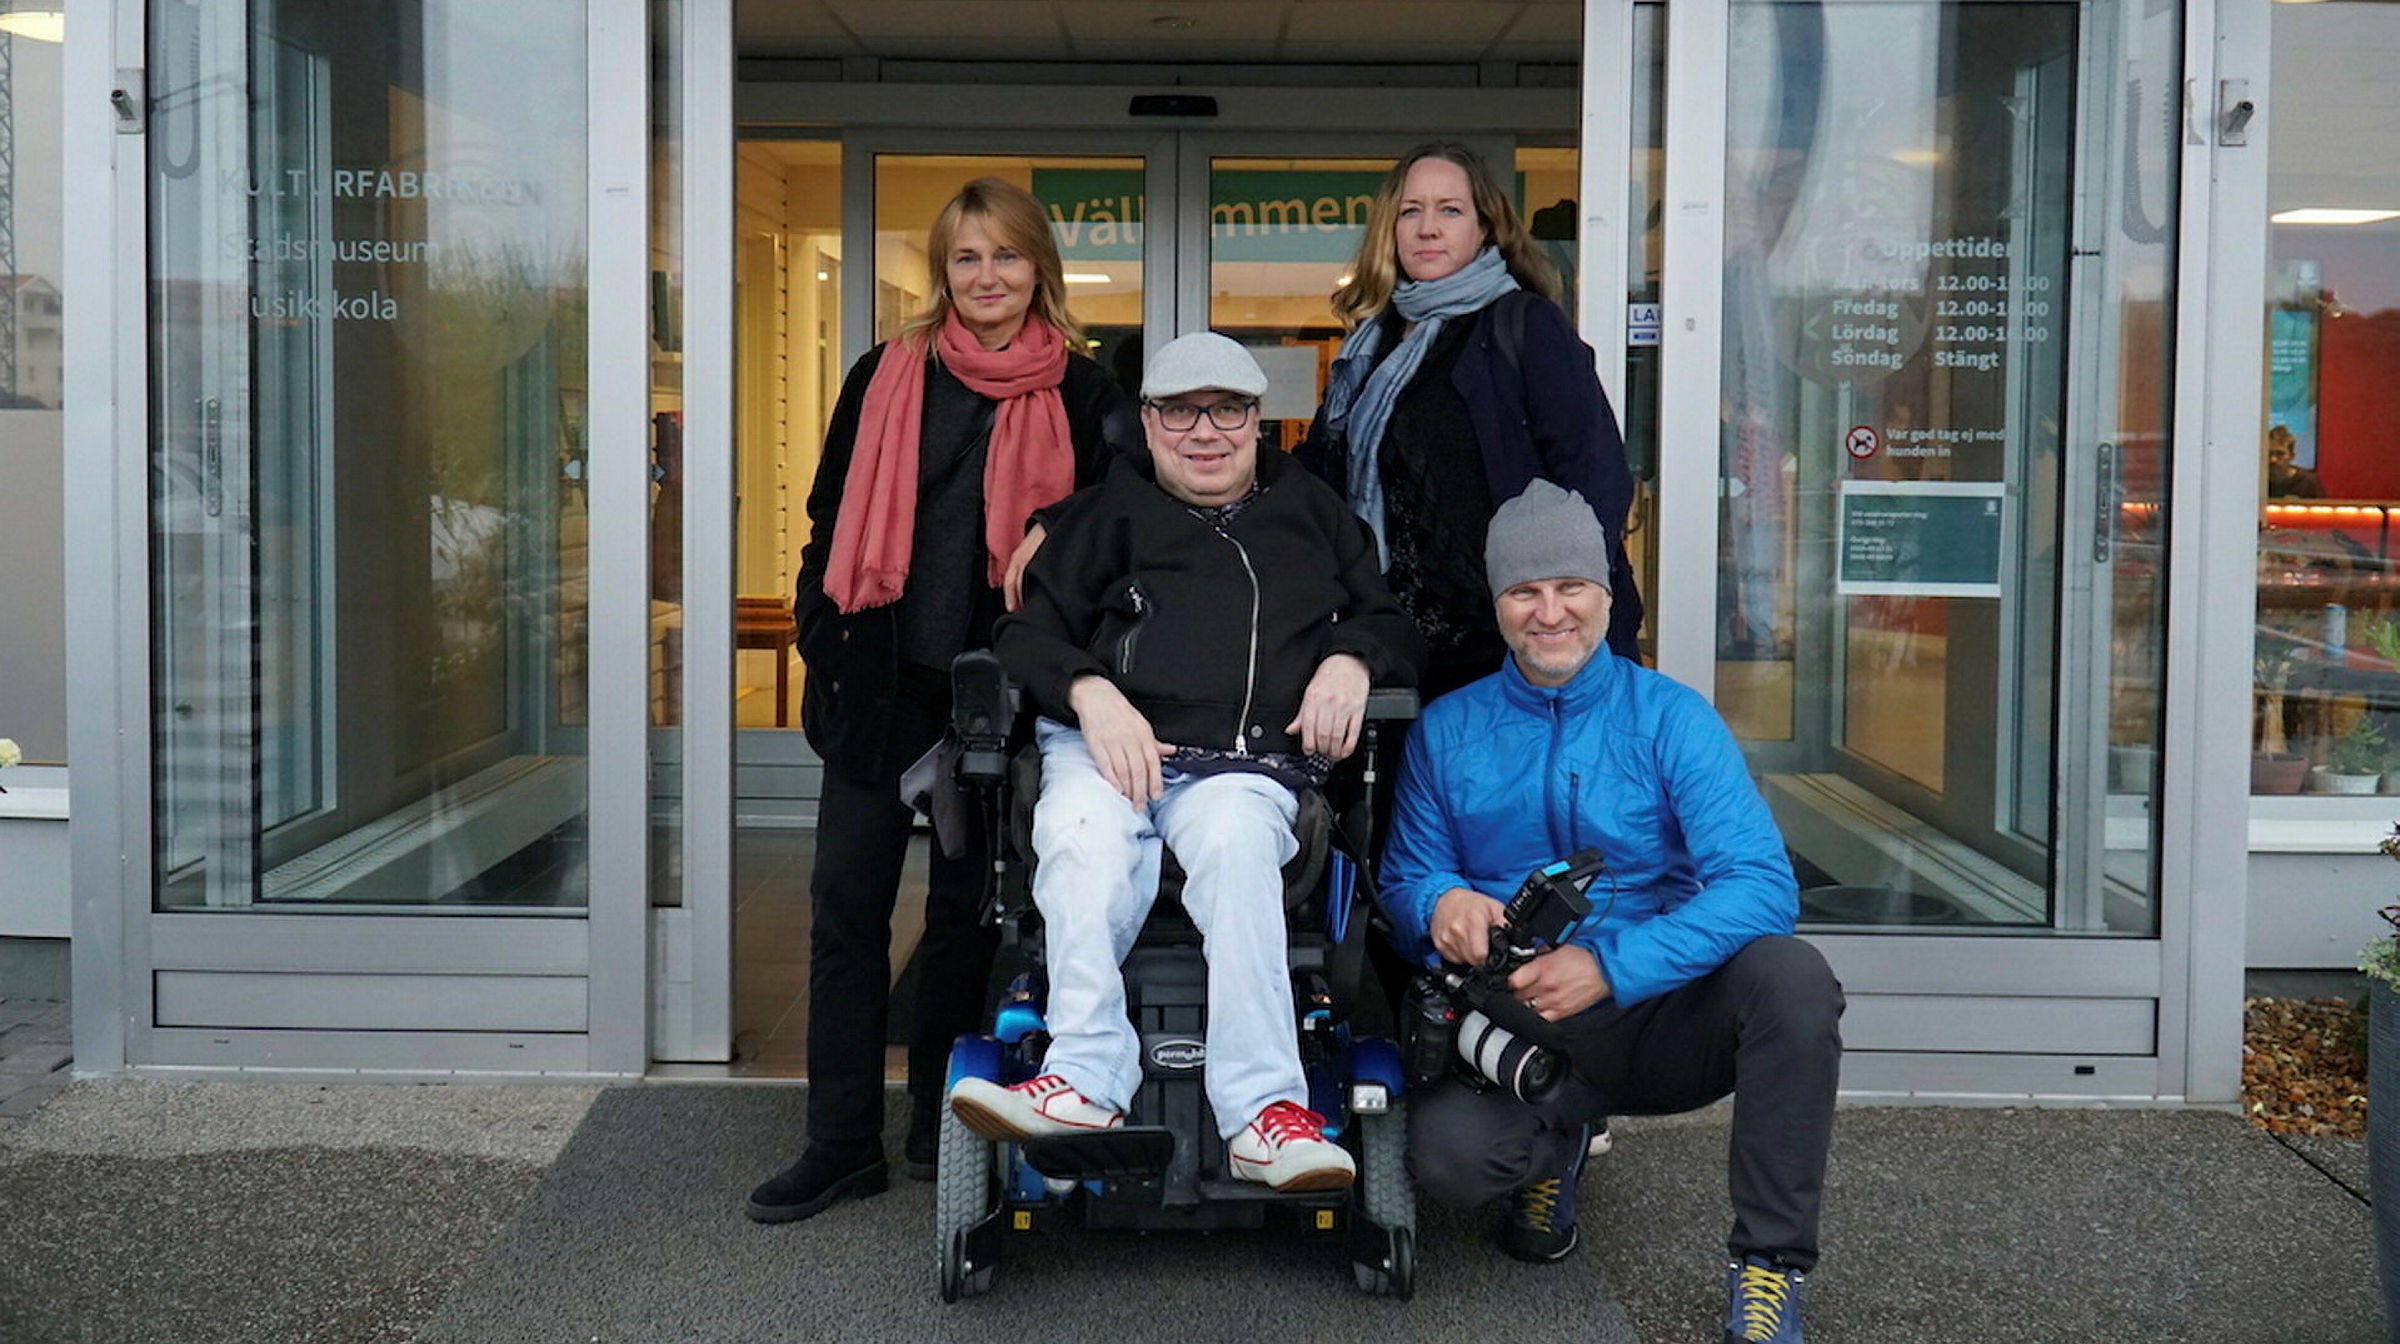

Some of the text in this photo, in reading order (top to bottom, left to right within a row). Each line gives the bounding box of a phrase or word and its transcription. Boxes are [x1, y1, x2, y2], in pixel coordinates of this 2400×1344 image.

[221, 168, 523, 200] KULTRFABRIKEN
[1049, 195, 1373, 248] Välmmen
[1937, 275, 2049, 291] 12.00-1.00
[250, 290, 398, 320] usikskola
[1833, 300, 2049, 319] Fredag 12.00-1.00
[1832, 325, 2048, 345] Lördag 12.00-1.00
[1831, 349, 2000, 370] Söndag Stängt
[1886, 428, 1908, 440] Var
[1910, 428, 1935, 443] god
[1937, 429, 1959, 443] tag
[1961, 428, 1973, 443] ej
[1886, 445, 1951, 456] hunden in
